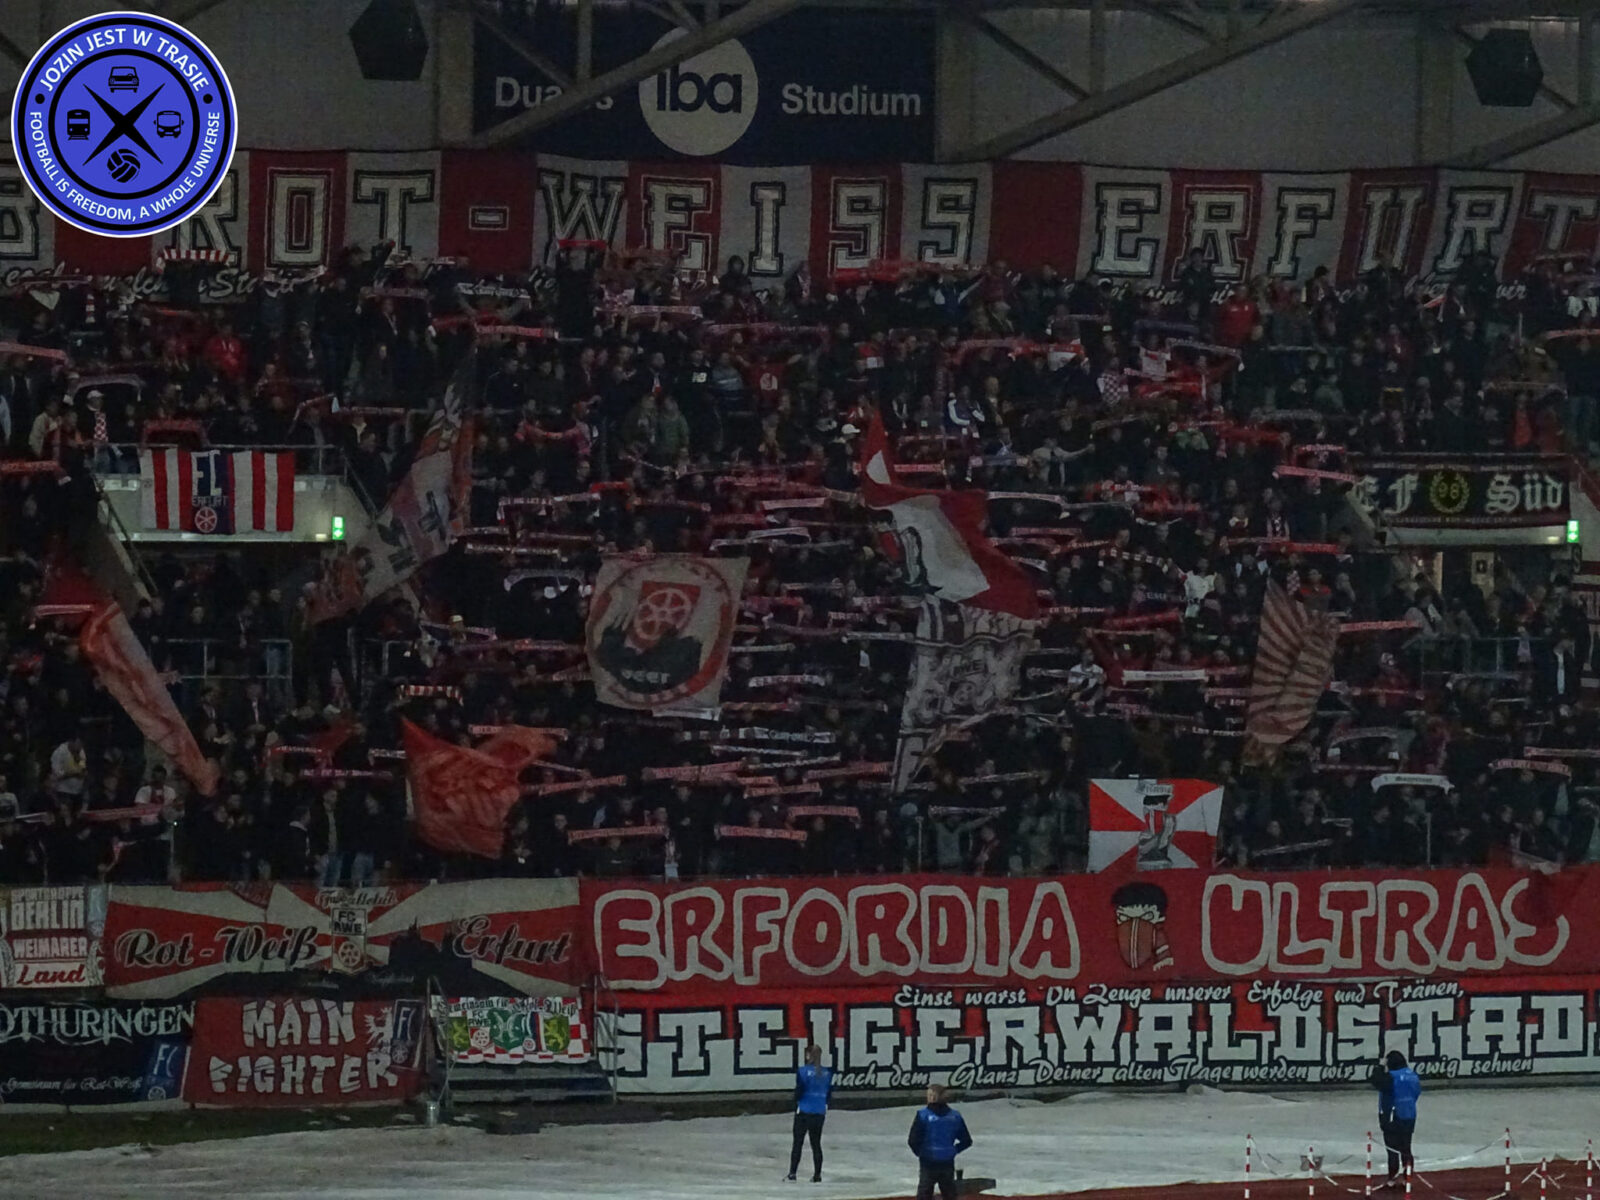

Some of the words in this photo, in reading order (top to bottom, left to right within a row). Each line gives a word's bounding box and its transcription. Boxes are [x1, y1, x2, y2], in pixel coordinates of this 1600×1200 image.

[494, 76, 614, 112] Duas
[781, 82, 921, 117] Studium
[1092, 180, 1600, 283] ERFURT
[1484, 473, 1563, 516] Süd
[338, 910, 356, 922] FC
[594, 881, 1082, 989] ERFORDIA
[1200, 872, 1571, 976] ULTRAS
[452, 915, 573, 965] Erfurt
[17, 964, 86, 985] Land
[894, 985, 952, 1007] Einst
[965, 987, 1027, 1005] warst
[1046, 985, 1076, 1006] Du
[1082, 984, 1151, 1008] Zeuge
[1165, 985, 1232, 1001] unserer
[1247, 980, 1323, 1010] Erfolge
[1335, 983, 1365, 1002] und
[1373, 979, 1465, 1009] Tränen,
[242, 998, 356, 1048] MAIN
[473, 1010, 484, 1018] FC
[597, 993, 1600, 1076] STEIGERWALDSTAD
[152, 1043, 178, 1078] FC
[209, 1052, 398, 1095] FIGHTER
[832, 1062, 877, 1087] nach
[891, 1064, 930, 1087] dem
[950, 1061, 1017, 1090] Glanz
[1029, 1059, 1103, 1084] Deiner
[1115, 1062, 1164, 1081] alten
[1243, 1058, 1309, 1081] werden
[1321, 1064, 1354, 1081] wir
[1472, 1052, 1534, 1075] sehnen
